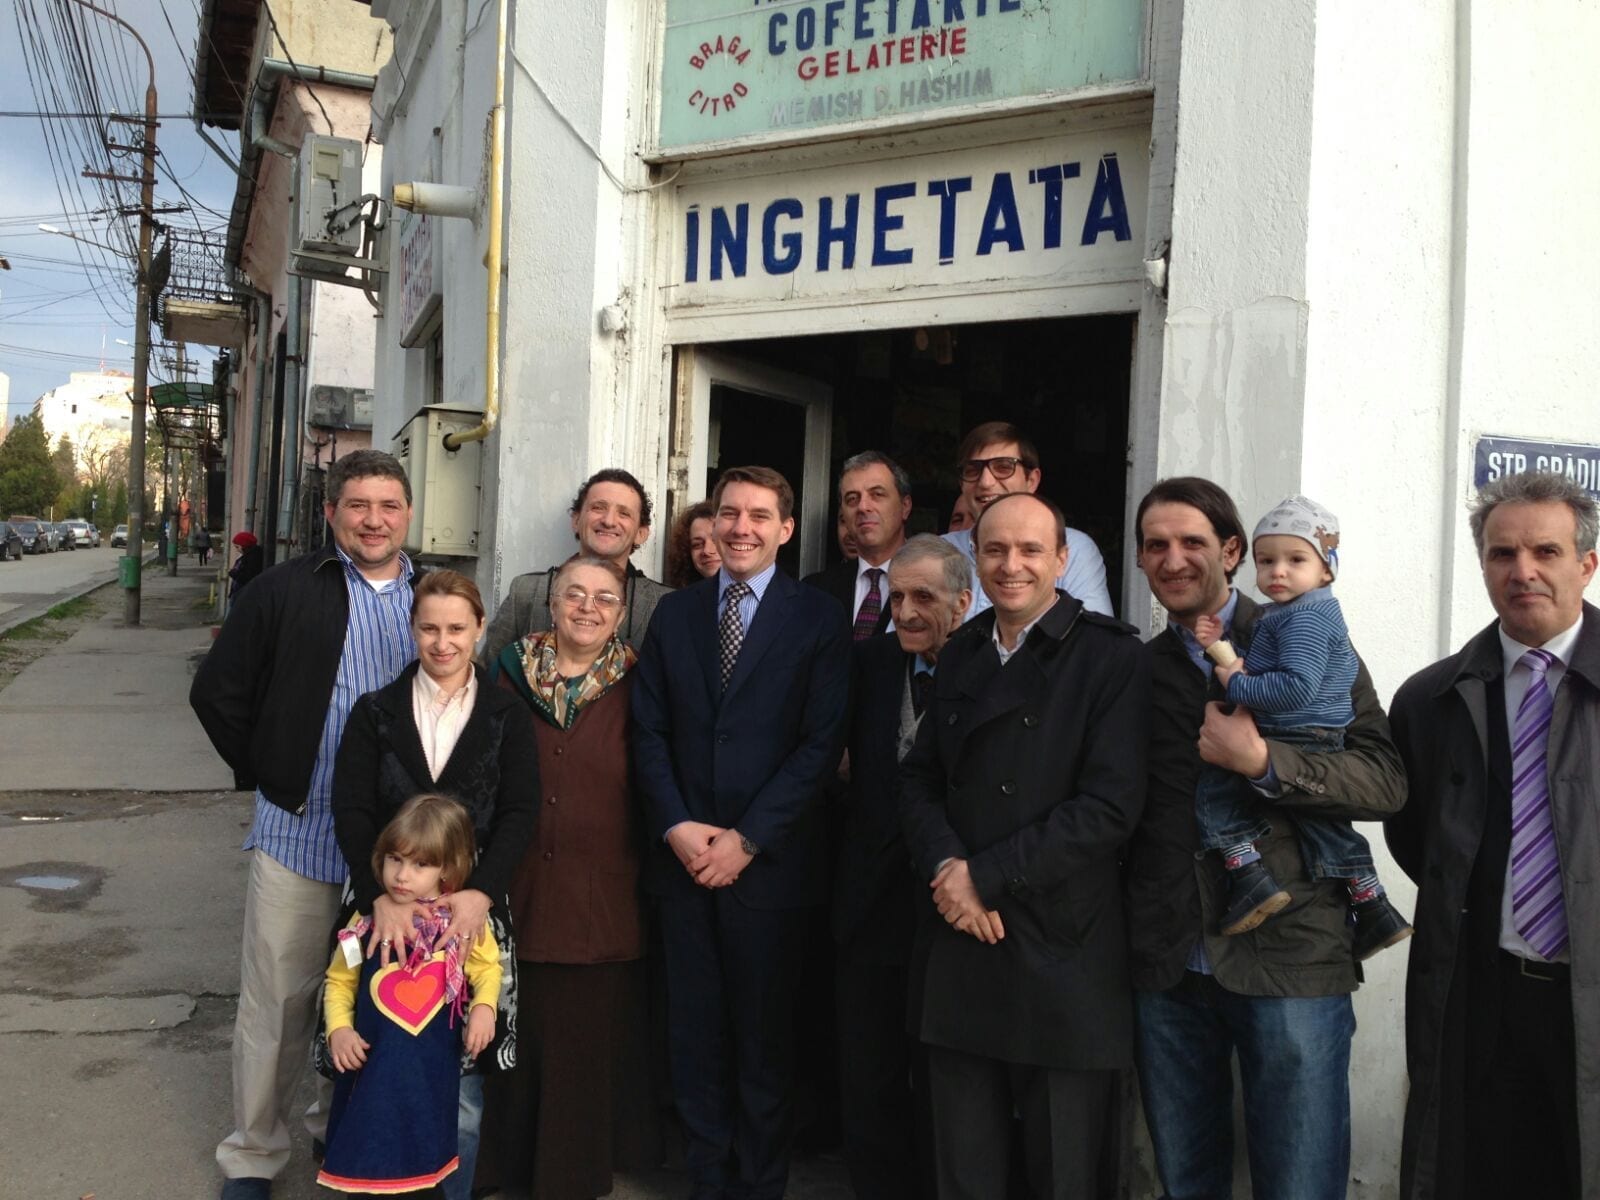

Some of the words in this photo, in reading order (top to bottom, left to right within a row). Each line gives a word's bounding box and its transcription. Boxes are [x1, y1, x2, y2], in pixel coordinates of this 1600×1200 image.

[689, 35, 751, 70] BRAGA
[797, 28, 967, 80] GELATERIE
[688, 82, 748, 116] CITRO
[901, 67, 993, 107] HASHIM
